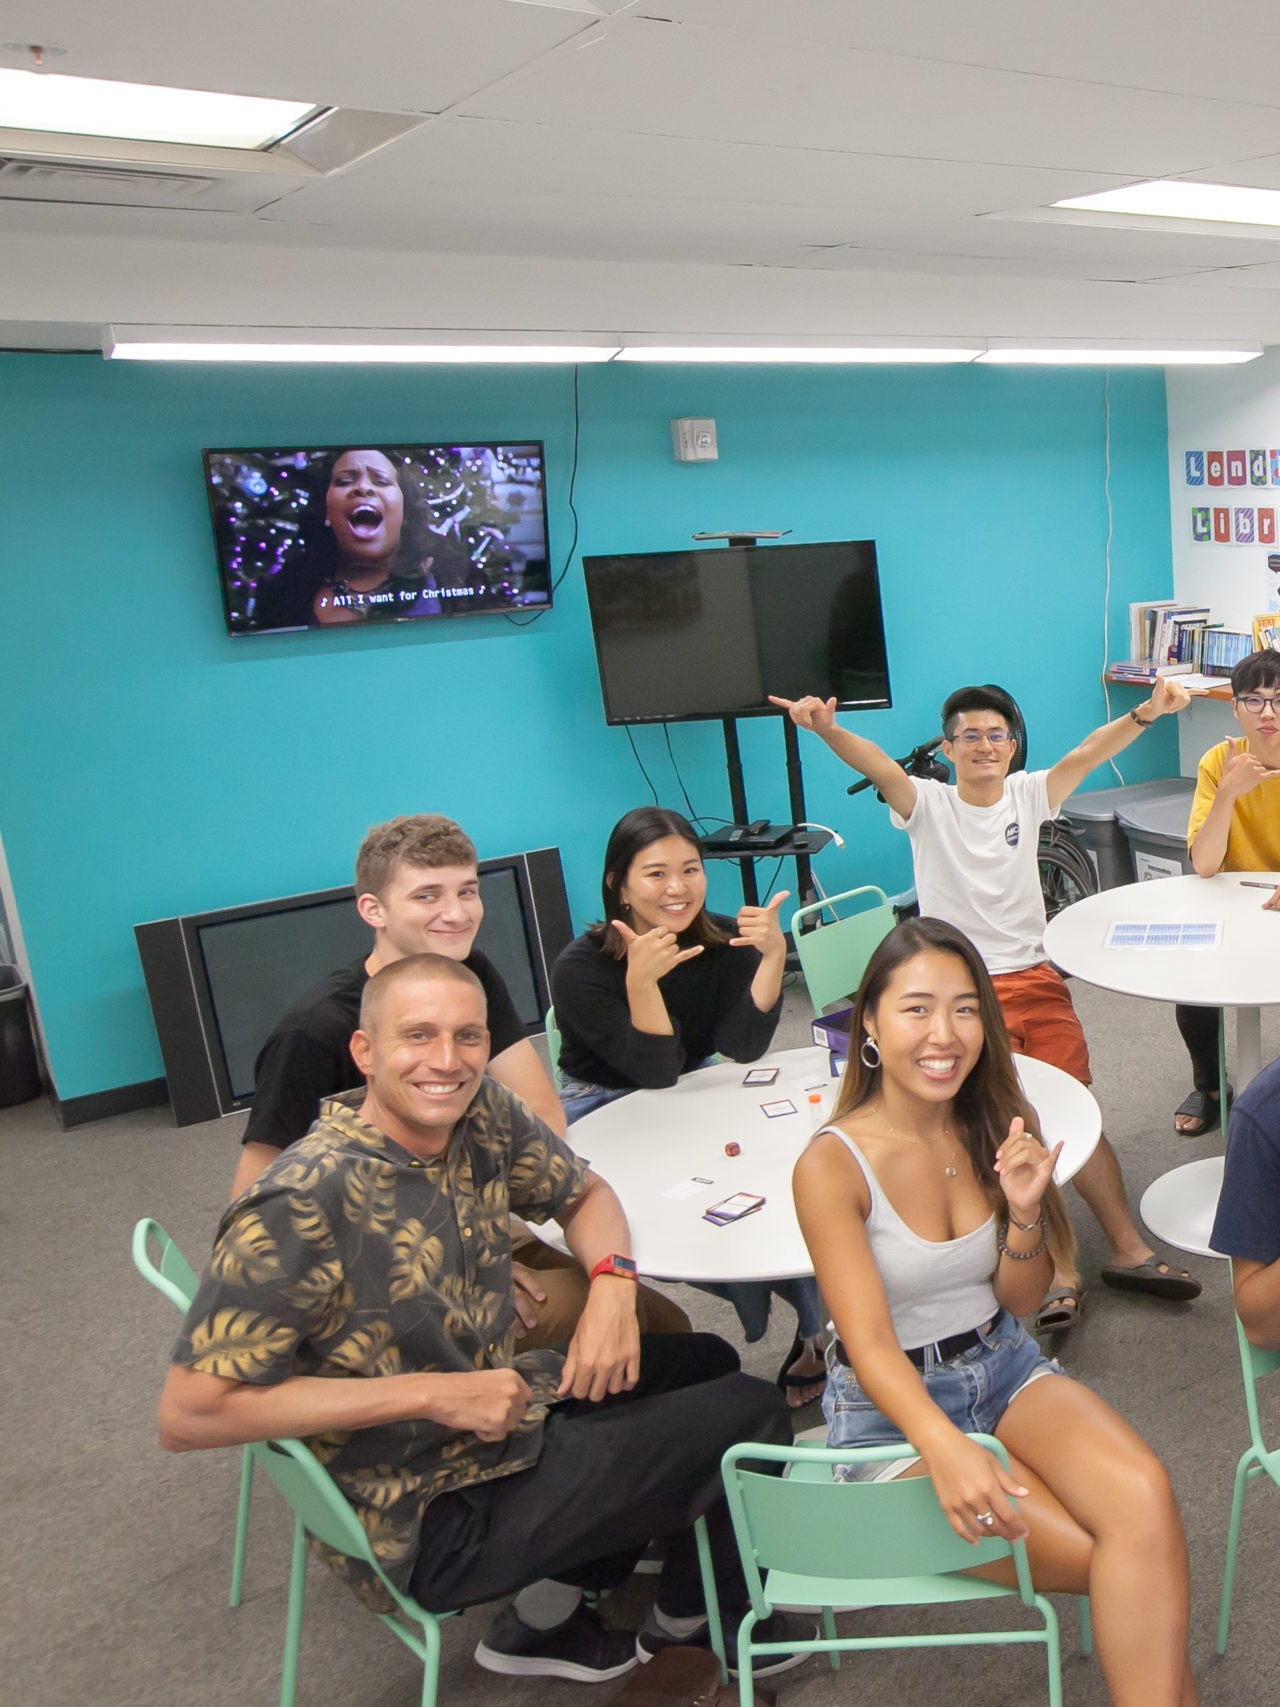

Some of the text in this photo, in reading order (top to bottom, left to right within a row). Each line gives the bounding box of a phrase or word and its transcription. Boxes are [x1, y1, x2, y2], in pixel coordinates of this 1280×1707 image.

[333, 585, 474, 607] All I want for Christmas
